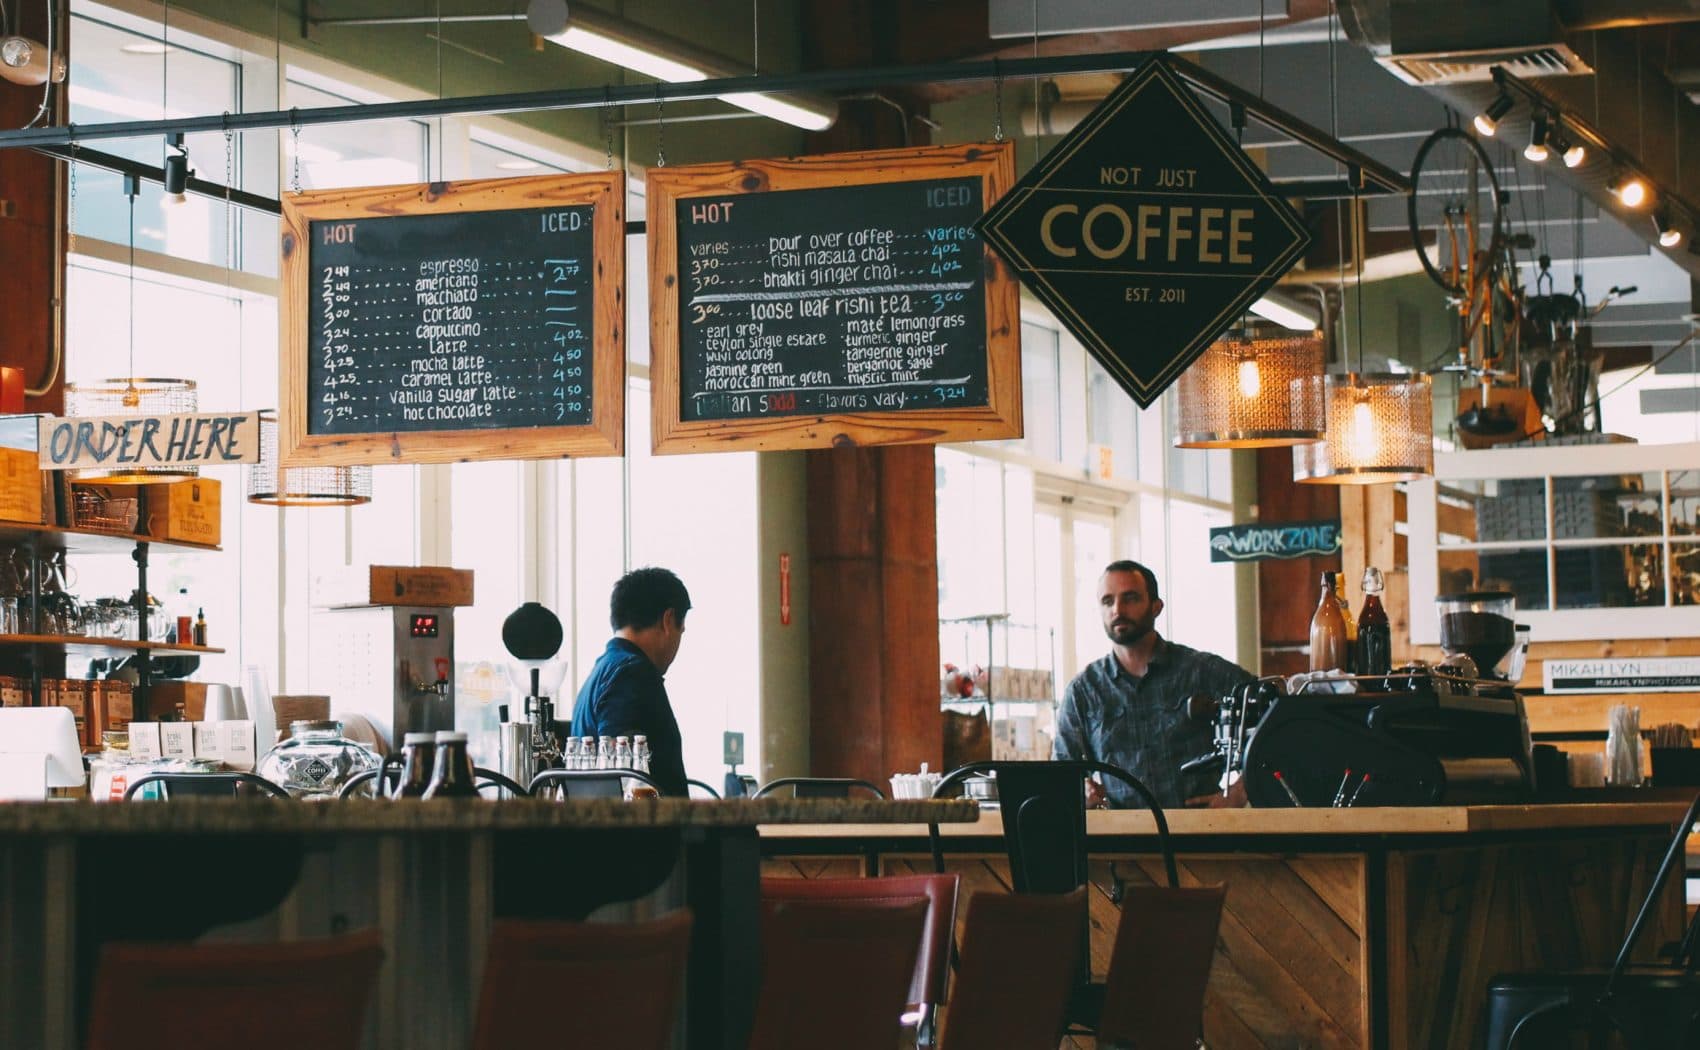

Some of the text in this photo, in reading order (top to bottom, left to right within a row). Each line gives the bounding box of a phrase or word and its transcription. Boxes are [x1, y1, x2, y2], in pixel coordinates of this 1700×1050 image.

[1100, 167, 1197, 188] NOT JUST
[926, 186, 971, 208] ICED
[541, 212, 581, 233] ICED
[691, 202, 734, 225] HOT
[323, 223, 357, 246] HOT
[690, 226, 976, 256] varies pour over coffee varies
[1040, 203, 1255, 264] COFFEE
[771, 251, 800, 268] rishi
[804, 249, 856, 266] masala
[861, 245, 890, 262] chai
[419, 258, 479, 279] espresso
[764, 269, 805, 288] bhakti
[810, 265, 861, 286] ginger
[864, 263, 897, 281] chai
[415, 273, 478, 291] americano
[416, 288, 478, 306] macchiato
[1125, 287, 1186, 304] EST. 2011
[422, 305, 473, 323] cortado
[750, 302, 793, 321] loose
[800, 298, 830, 318] leaf
[835, 296, 874, 316] rishi
[880, 294, 913, 314] tea
[416, 322, 481, 341] cappuccino
[706, 322, 764, 338] earl grey
[891, 314, 966, 331] lemongrass
[706, 332, 827, 352] ceylon single estate
[846, 330, 937, 347] turmeric ginger
[735, 347, 774, 361] oolong
[846, 342, 949, 361] tangerine ginger
[411, 356, 448, 372] mocha
[452, 355, 485, 371] latte
[705, 361, 783, 379] jasmine green
[847, 356, 933, 374] bergamot sage
[401, 372, 453, 387] caramel
[458, 371, 492, 385] latte
[705, 370, 832, 391] moroccan mint green
[848, 369, 920, 386] mystic mint
[389, 388, 433, 404] vanilla
[438, 387, 478, 403] sugar
[482, 385, 517, 400] latte
[873, 390, 906, 409] vary
[403, 405, 425, 420] hot
[427, 402, 492, 421] chocolate
[50, 416, 248, 465] ORDER HERE
[1551, 664, 1603, 677] MIKAH
[1609, 663, 1641, 676] LYN
[1595, 677, 1700, 686] MIKAHLYNPHOTOGRA
